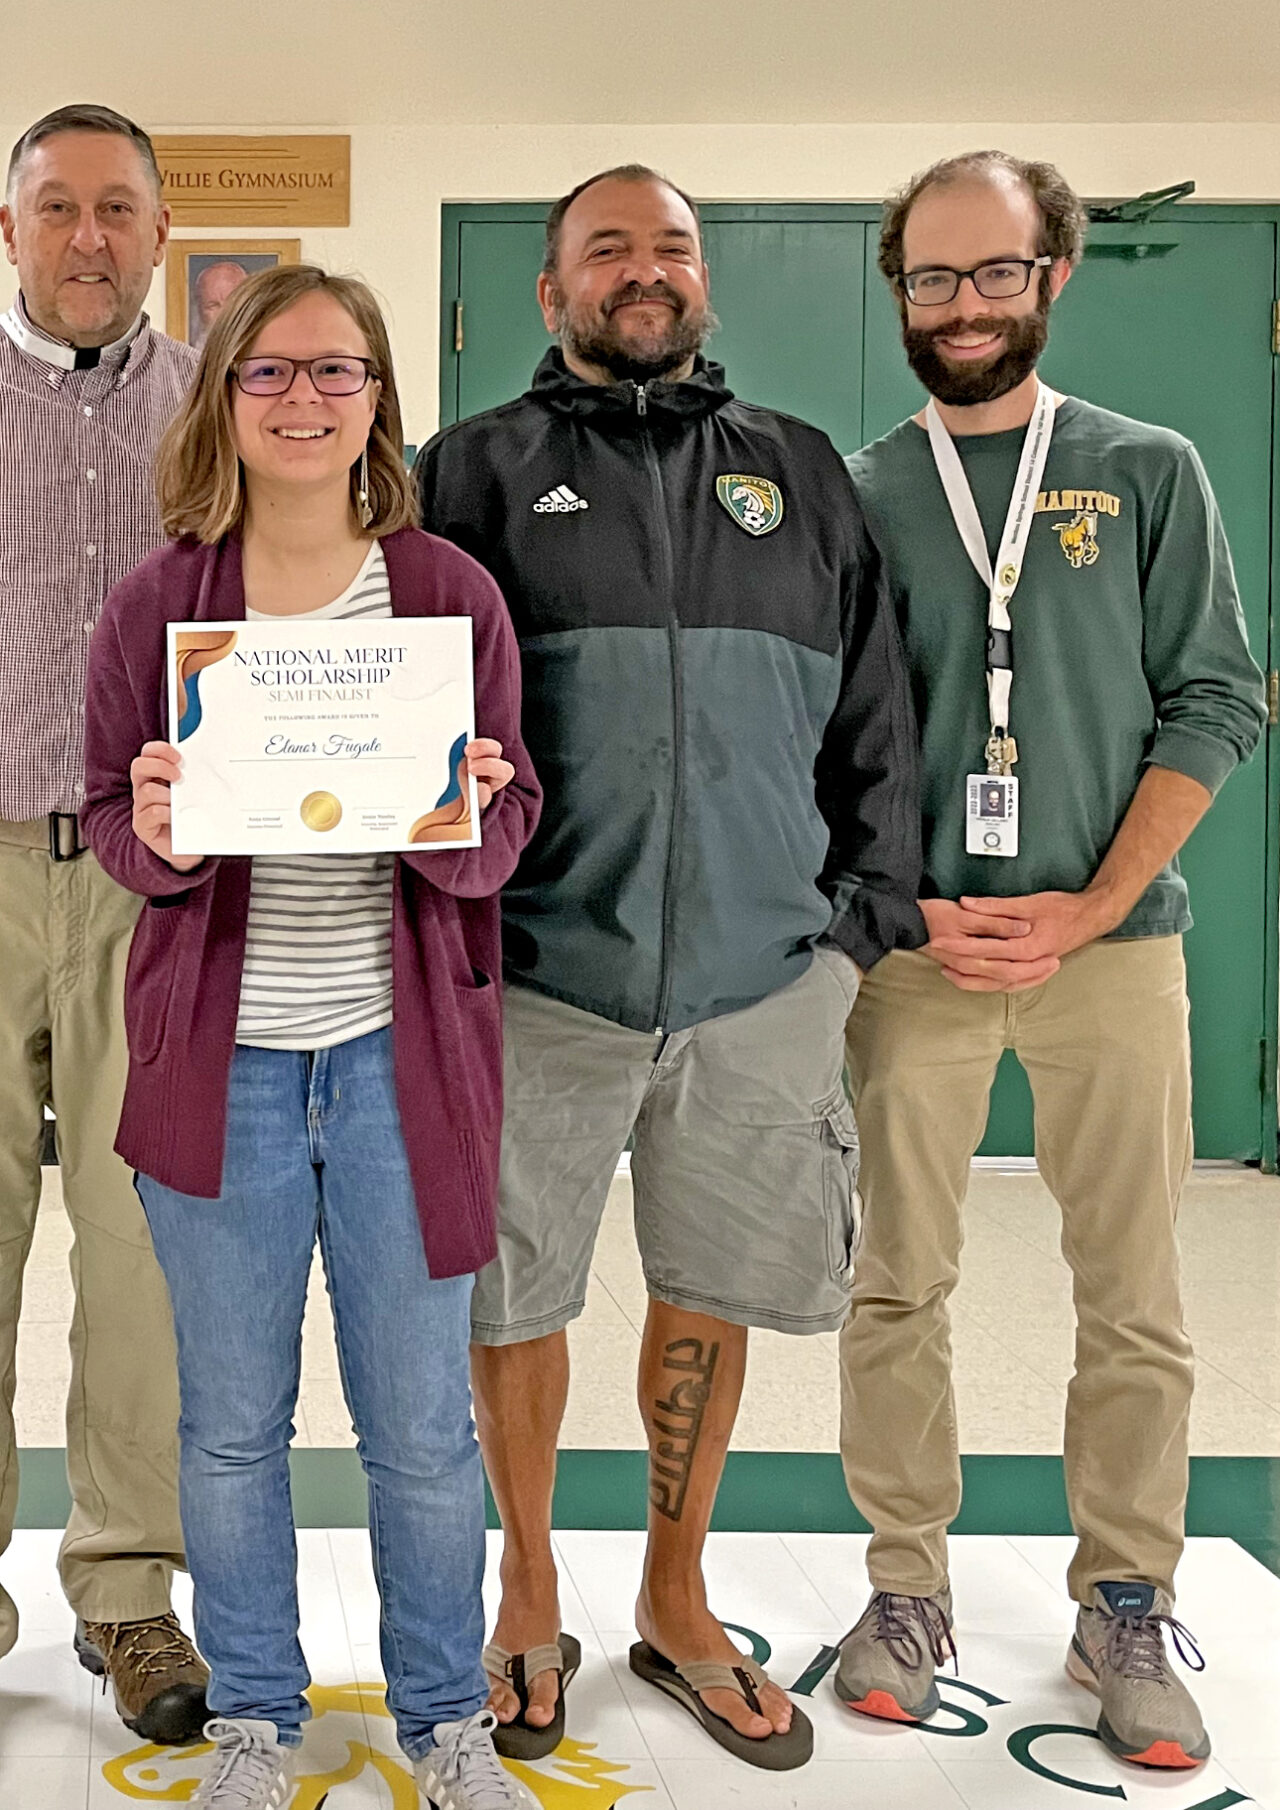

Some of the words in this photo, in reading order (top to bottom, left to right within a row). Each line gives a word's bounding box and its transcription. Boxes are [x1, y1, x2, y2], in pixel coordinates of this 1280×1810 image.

[218, 169, 334, 189] GYMNASIUM
[532, 500, 589, 513] adidas
[233, 649, 338, 667] NATIONAL
[344, 647, 408, 665] MERIT
[250, 668, 391, 687] SCHOLARSHIP
[269, 689, 305, 703] SEMI
[309, 688, 374, 702] FINALIST
[264, 734, 317, 755] Elanor
